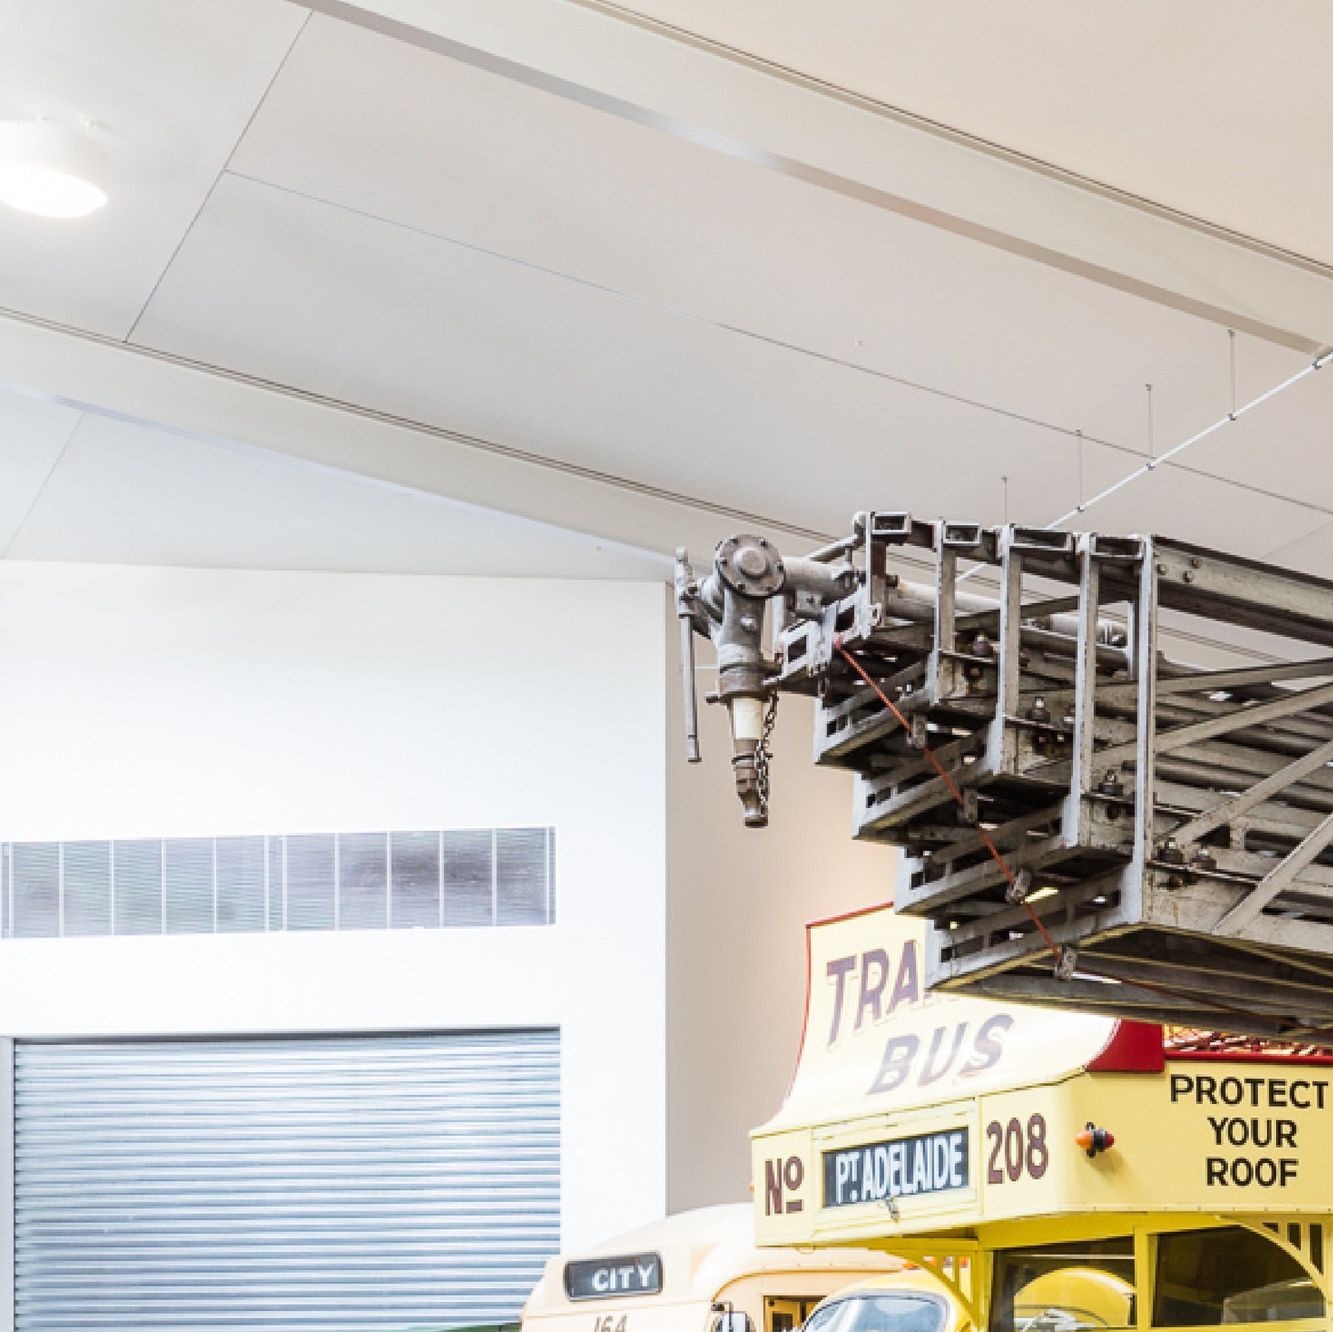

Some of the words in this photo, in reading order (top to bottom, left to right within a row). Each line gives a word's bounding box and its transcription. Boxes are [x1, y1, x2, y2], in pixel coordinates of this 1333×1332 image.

[826, 939, 932, 1049] TRA
[867, 1013, 1014, 1095] BUS
[1170, 1073, 1329, 1109] PROTECT
[986, 1113, 1049, 1185] 208
[1207, 1116, 1297, 1148] YOUR
[862, 1133, 963, 1202] ADELAIDE
[1206, 1157, 1299, 1187] ROOF
[591, 1264, 655, 1292] CITY
